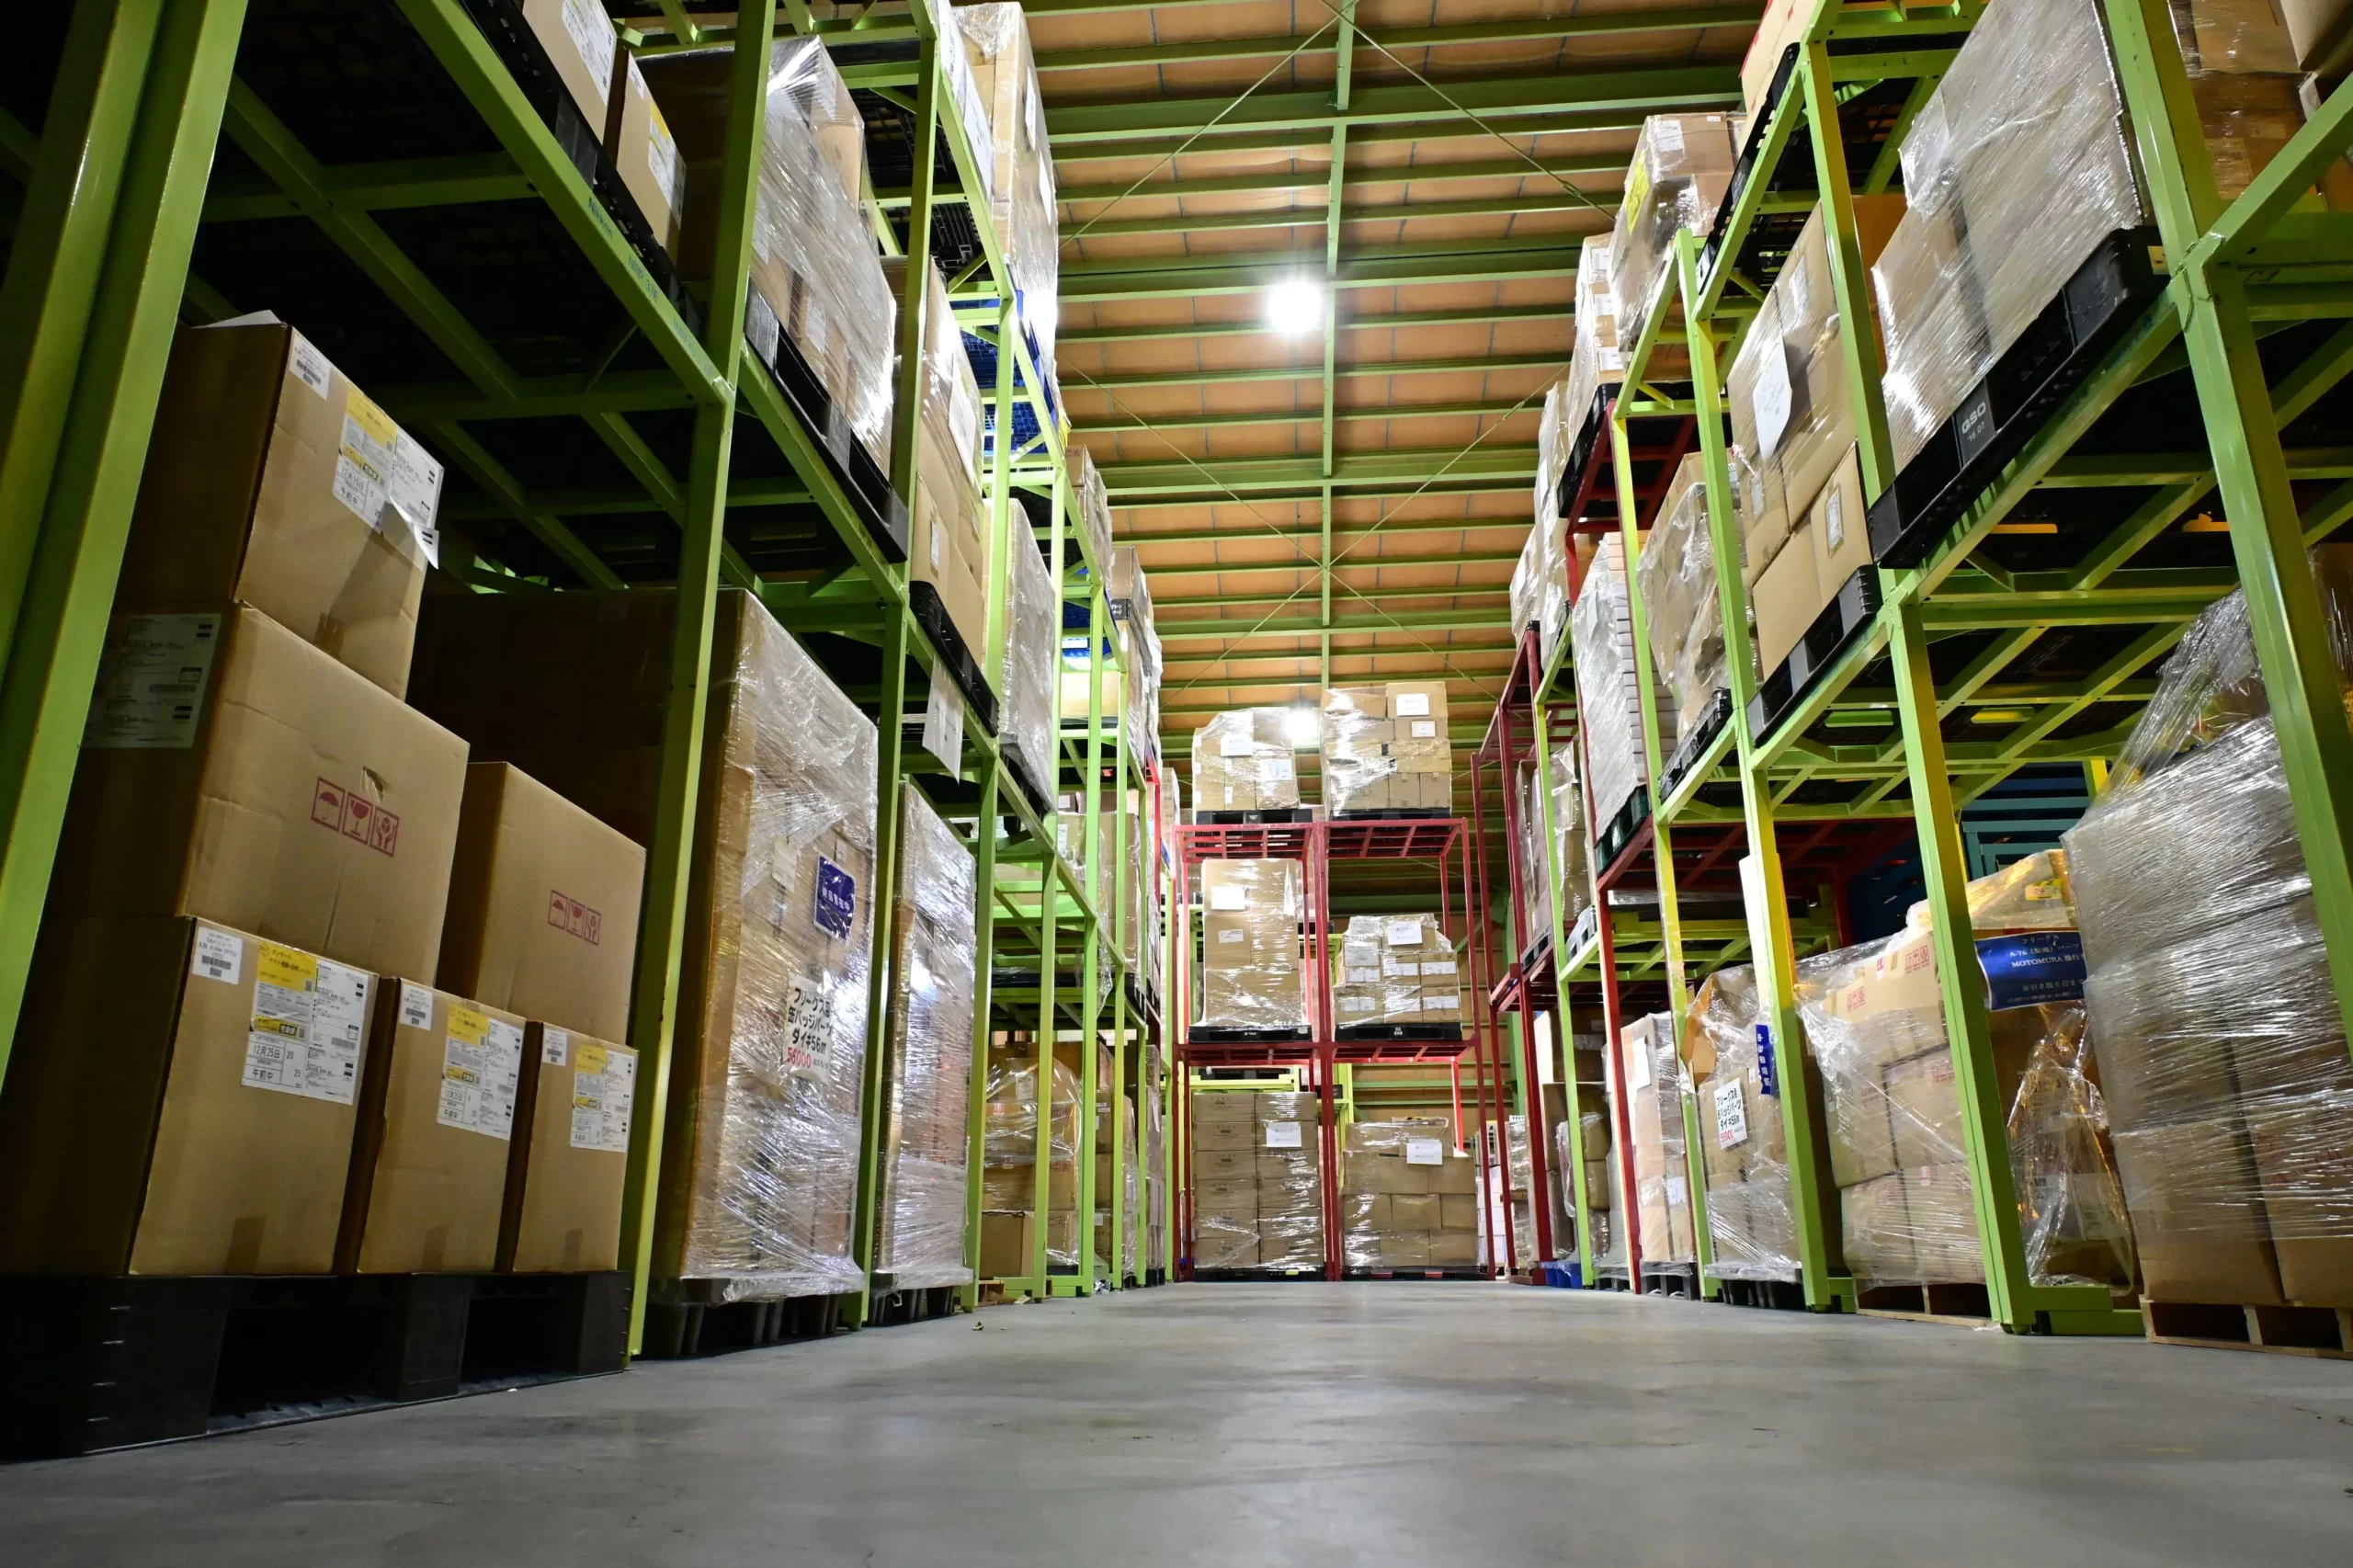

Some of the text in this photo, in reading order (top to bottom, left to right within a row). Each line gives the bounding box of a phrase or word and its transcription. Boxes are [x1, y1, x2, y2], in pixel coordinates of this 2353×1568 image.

[1961, 401, 1986, 435] QSO
[2011, 956, 2063, 968] MOTOMURA
[253, 1044, 280, 1059] 12月25日
[787, 1046, 812, 1070] 56000
[252, 1068, 274, 1081] 午前中
